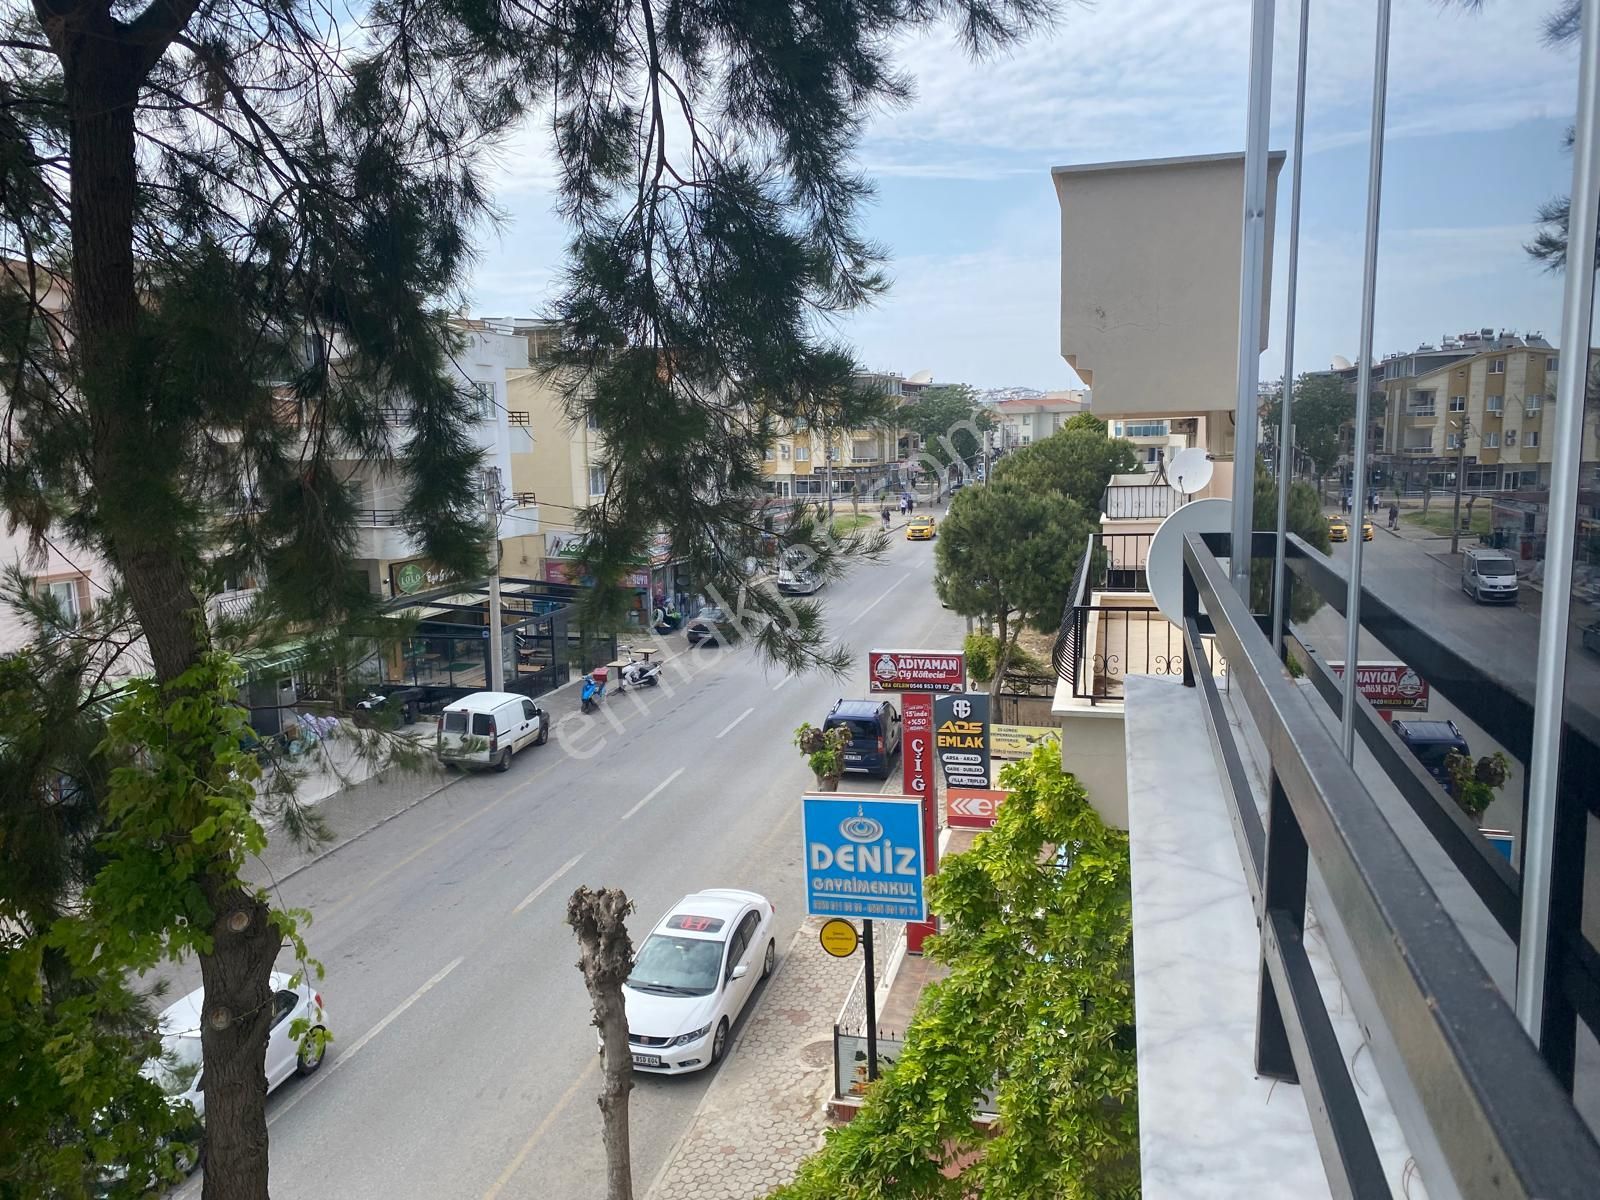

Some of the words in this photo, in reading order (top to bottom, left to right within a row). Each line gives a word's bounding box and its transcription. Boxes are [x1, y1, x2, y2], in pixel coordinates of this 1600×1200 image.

[898, 659, 957, 671] ADIYAMAN
[913, 671, 946, 679] Köftecisi
[937, 735, 984, 749] EMLAK
[810, 839, 917, 875] DENİZ
[813, 877, 917, 896] GAYRİMENKUL
